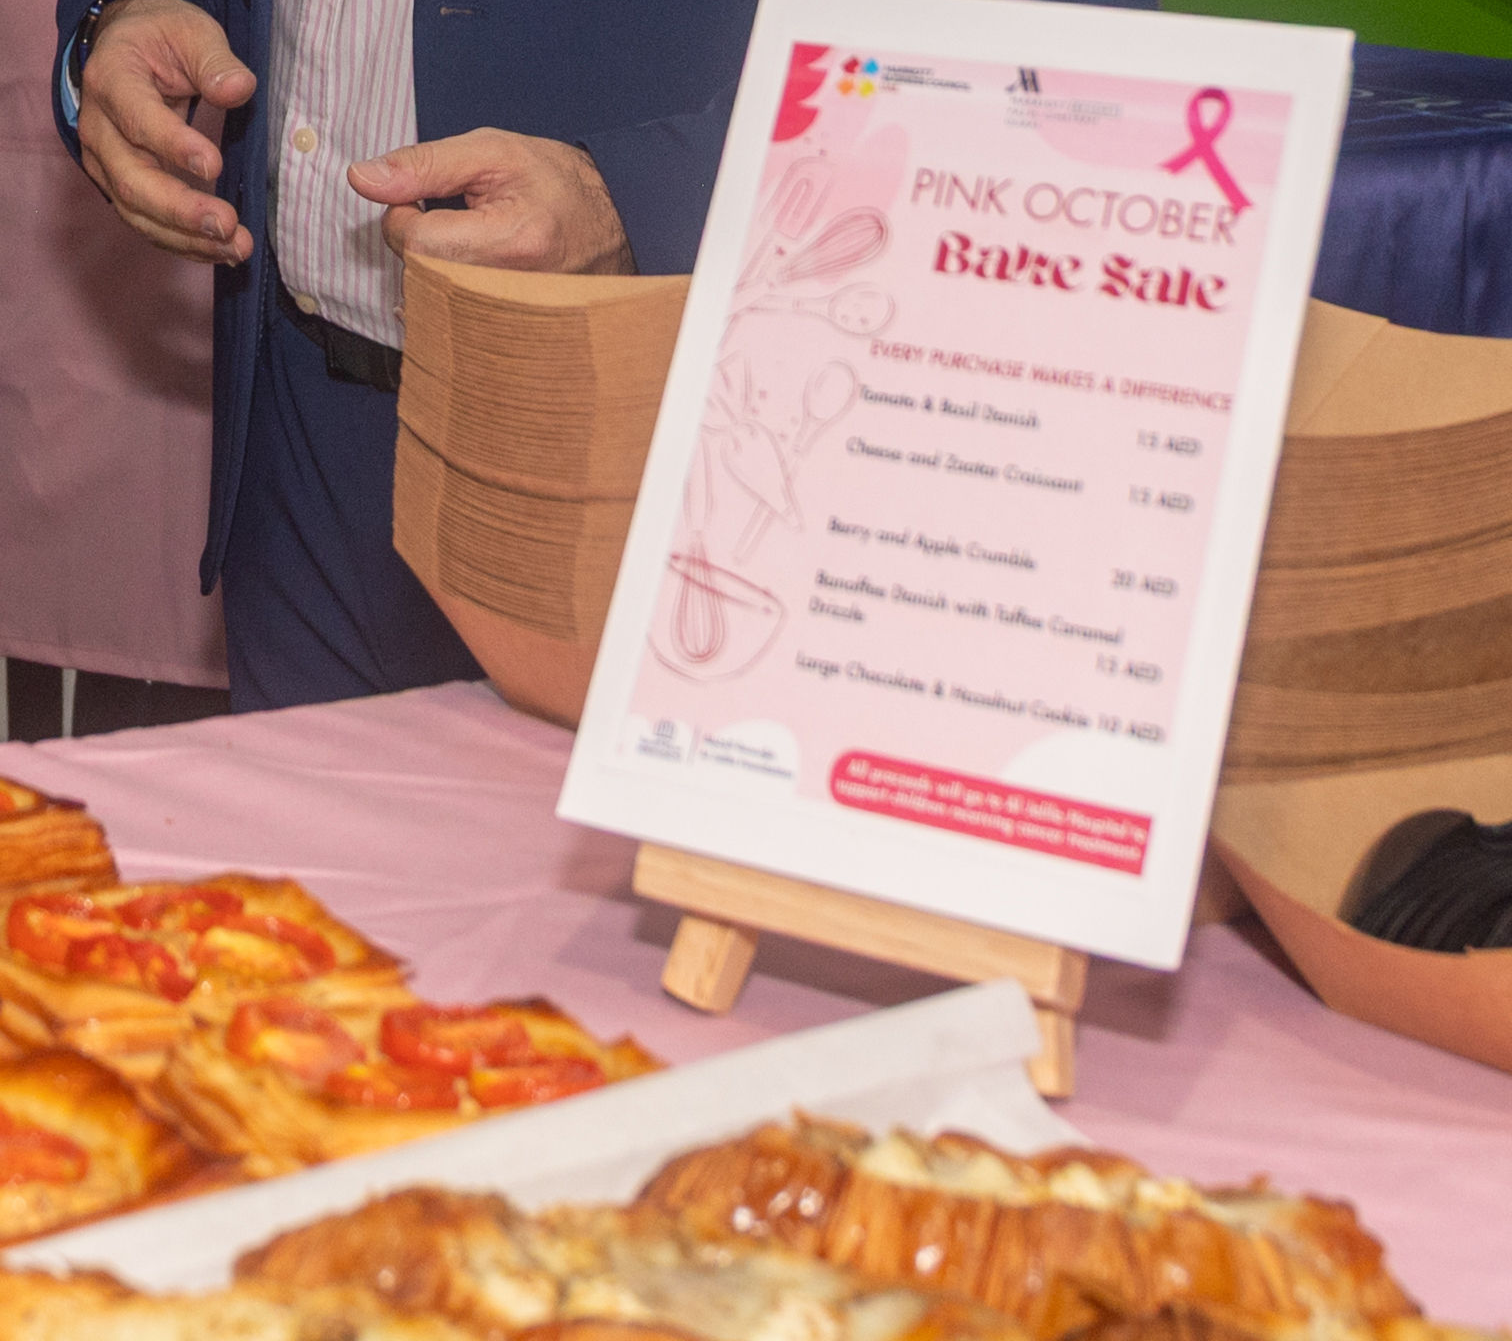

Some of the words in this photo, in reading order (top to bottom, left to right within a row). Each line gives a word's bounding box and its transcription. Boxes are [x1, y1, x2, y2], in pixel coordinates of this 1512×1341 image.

[910, 167, 1013, 216] PINK
[1023, 182, 1239, 245] OCTOBER
[932, 229, 1083, 292] Bake
[1098, 252, 1228, 312] Sale
[870, 338, 925, 364] EVERY
[928, 348, 1026, 380] PURCHASE
[1032, 367, 1094, 393] MAKES
[1100, 378, 1115, 394] A
[1119, 380, 1235, 414] DIFFERENCE
[953, 596, 989, 619] with
